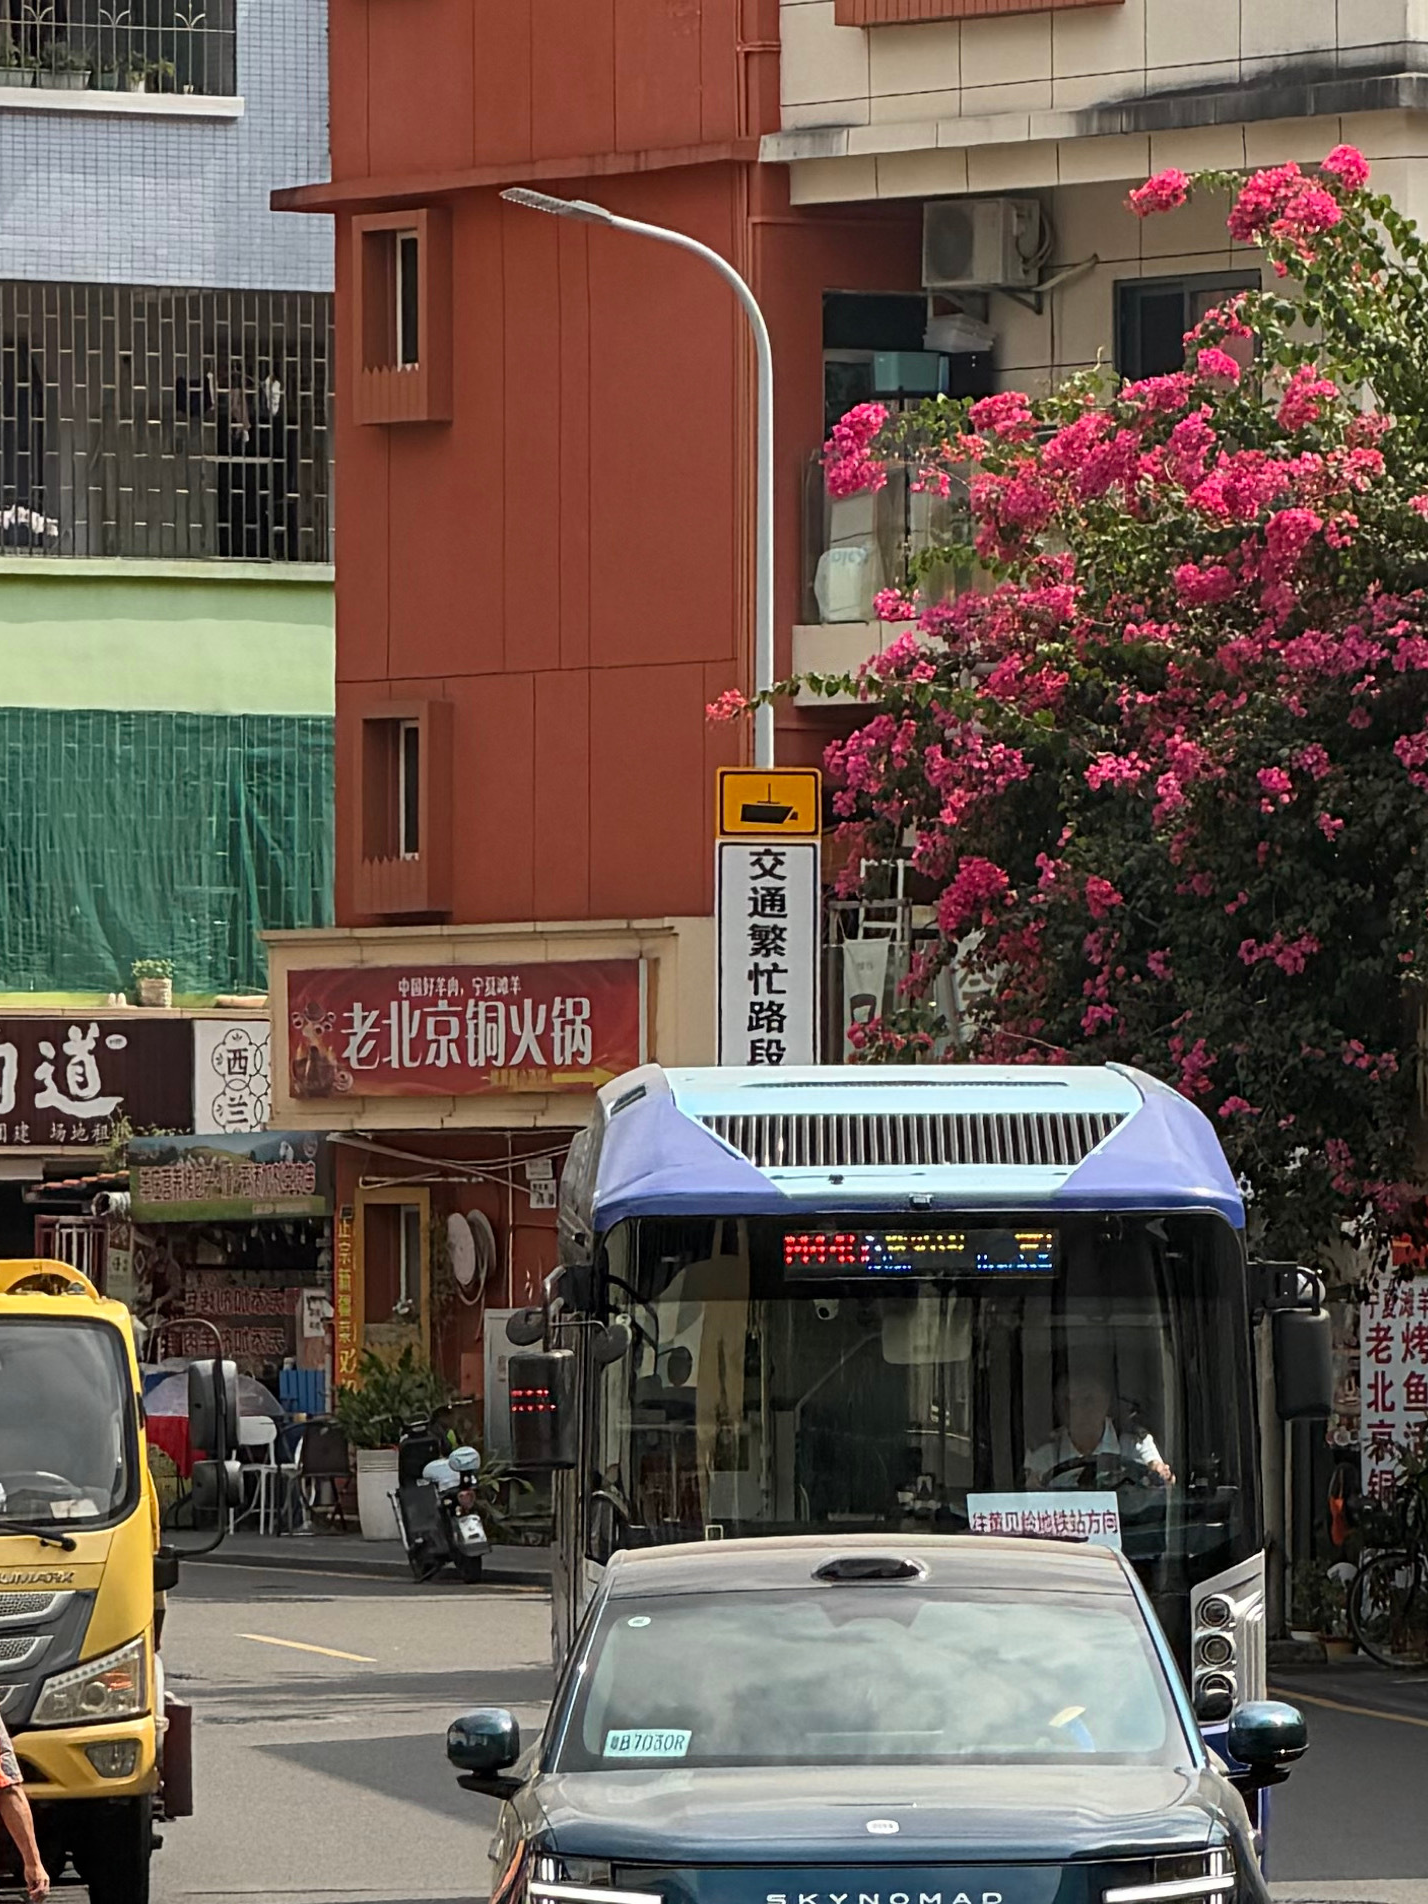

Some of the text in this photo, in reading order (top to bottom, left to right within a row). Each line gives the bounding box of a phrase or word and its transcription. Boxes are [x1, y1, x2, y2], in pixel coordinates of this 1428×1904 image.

[747, 848, 788, 1066] 交通繁忙路段
[341, 997, 592, 1069] 老北京铜火锅
[49, 1123, 123, 1145] 场地租
